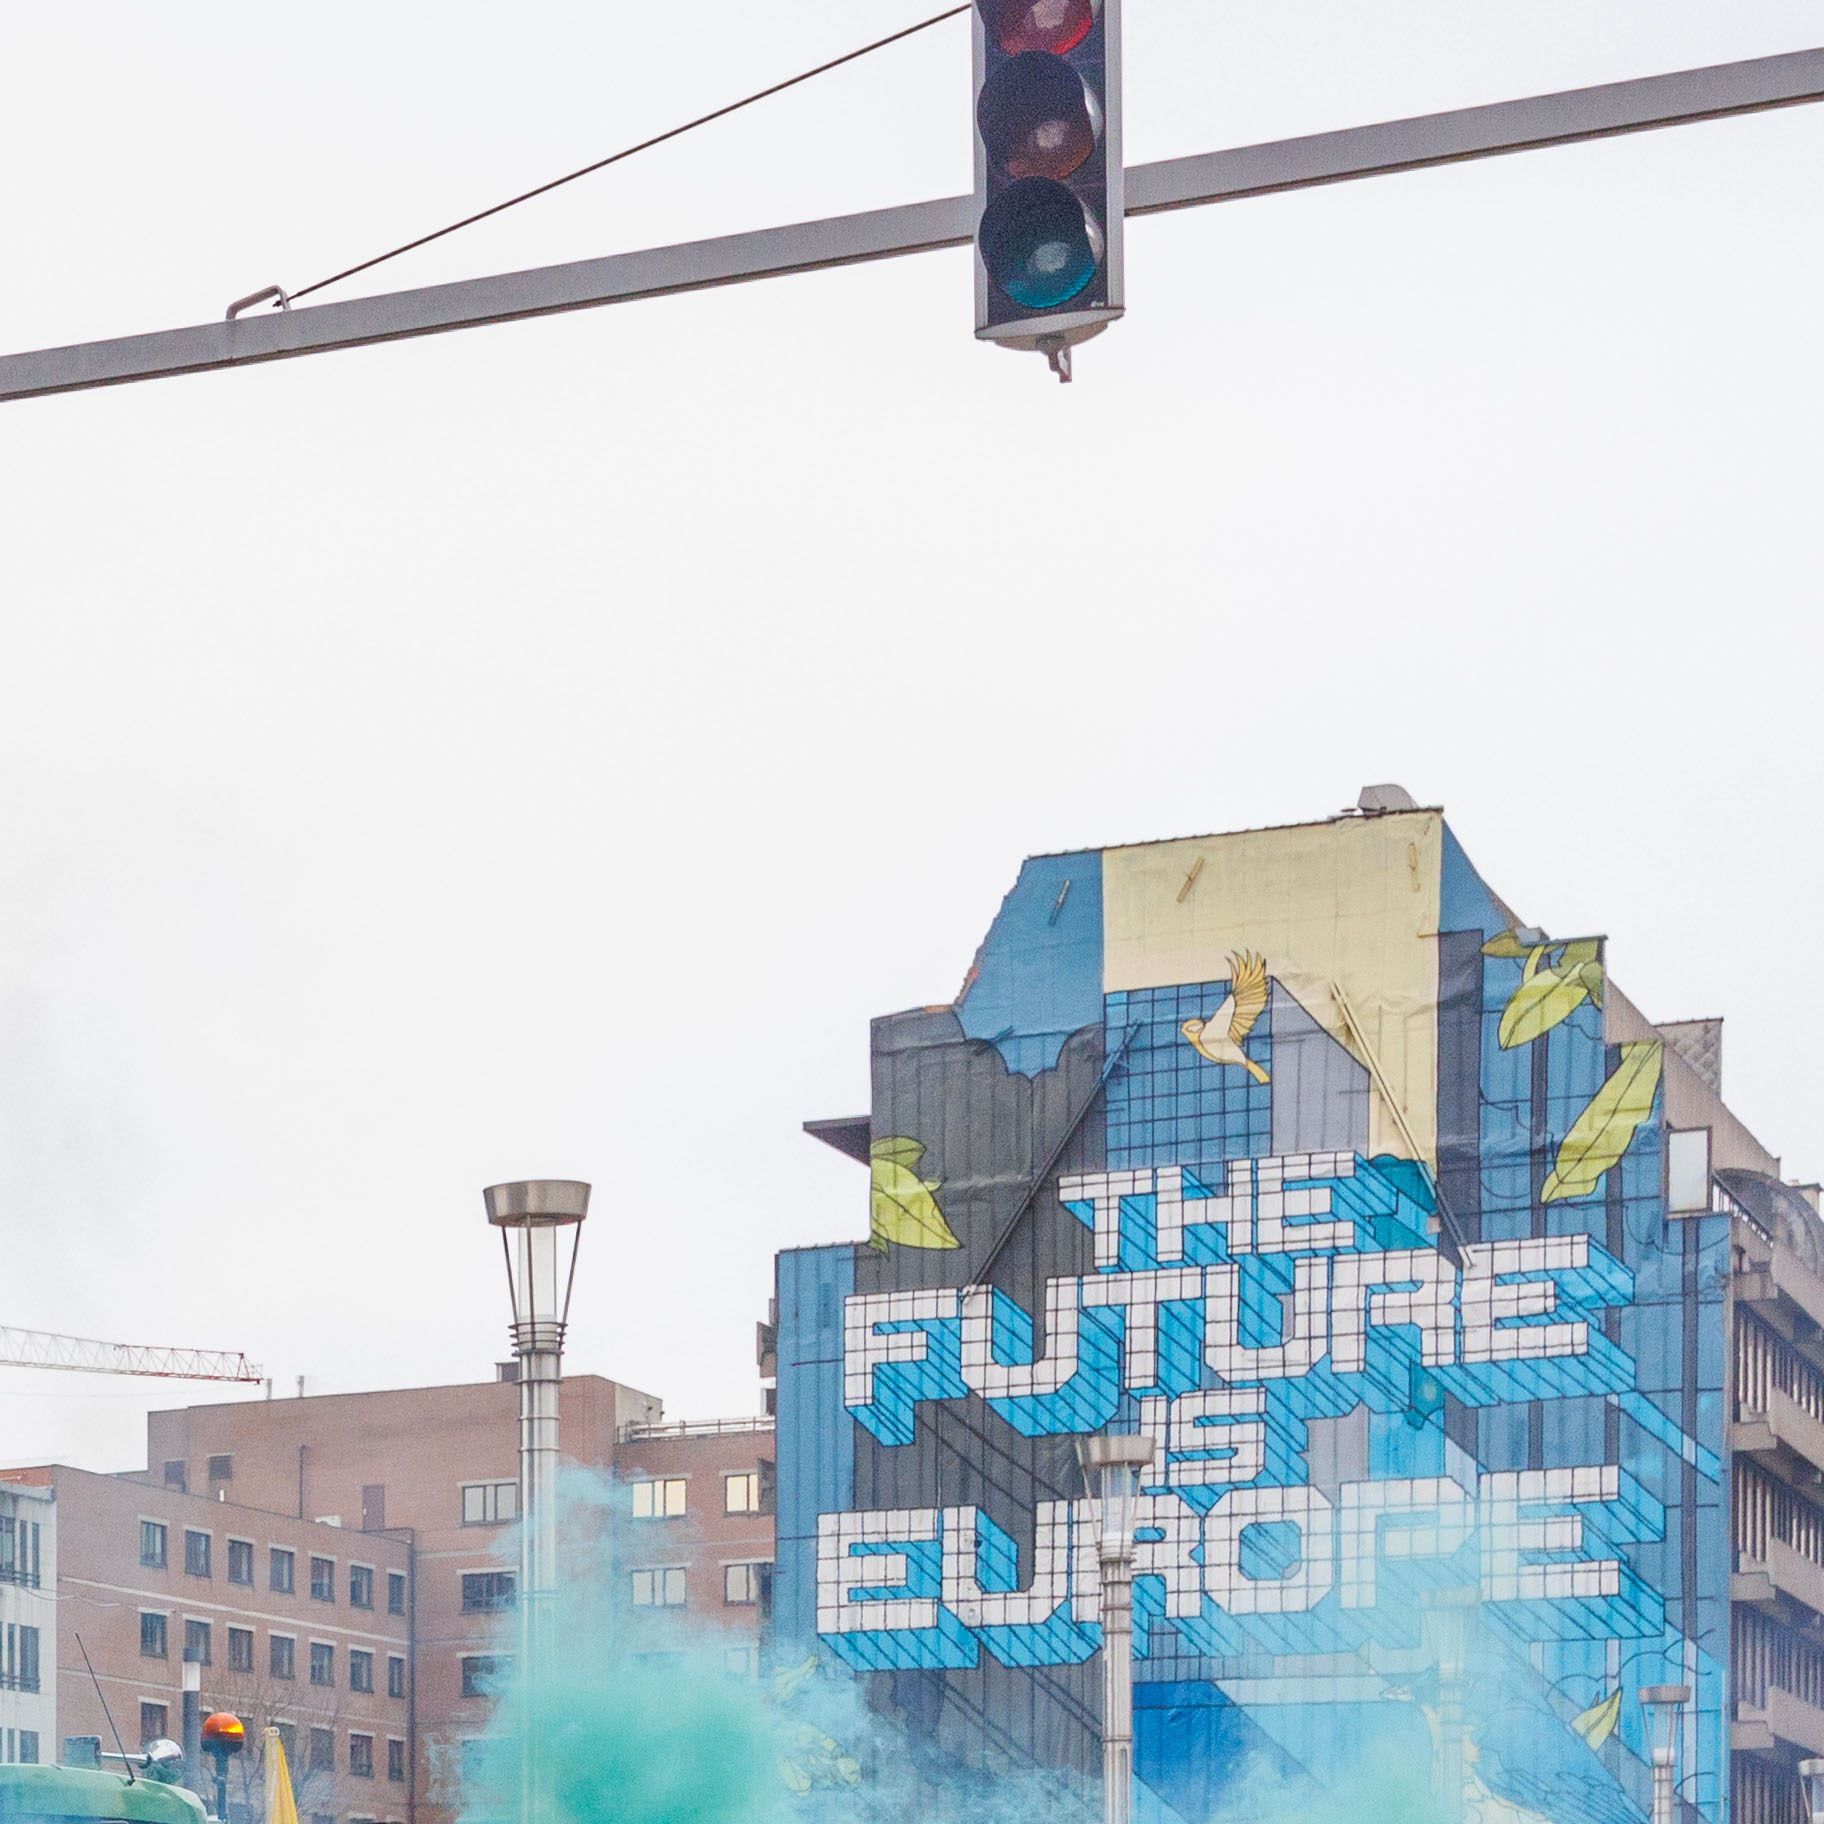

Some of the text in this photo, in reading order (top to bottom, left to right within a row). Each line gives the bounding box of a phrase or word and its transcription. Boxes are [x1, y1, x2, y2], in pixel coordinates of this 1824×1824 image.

[1058, 1150, 1358, 1268] THE
[843, 1234, 1594, 1410] FUTURE
[1139, 1385, 1270, 1490] IS
[816, 1464, 1624, 1636] EUROPE
